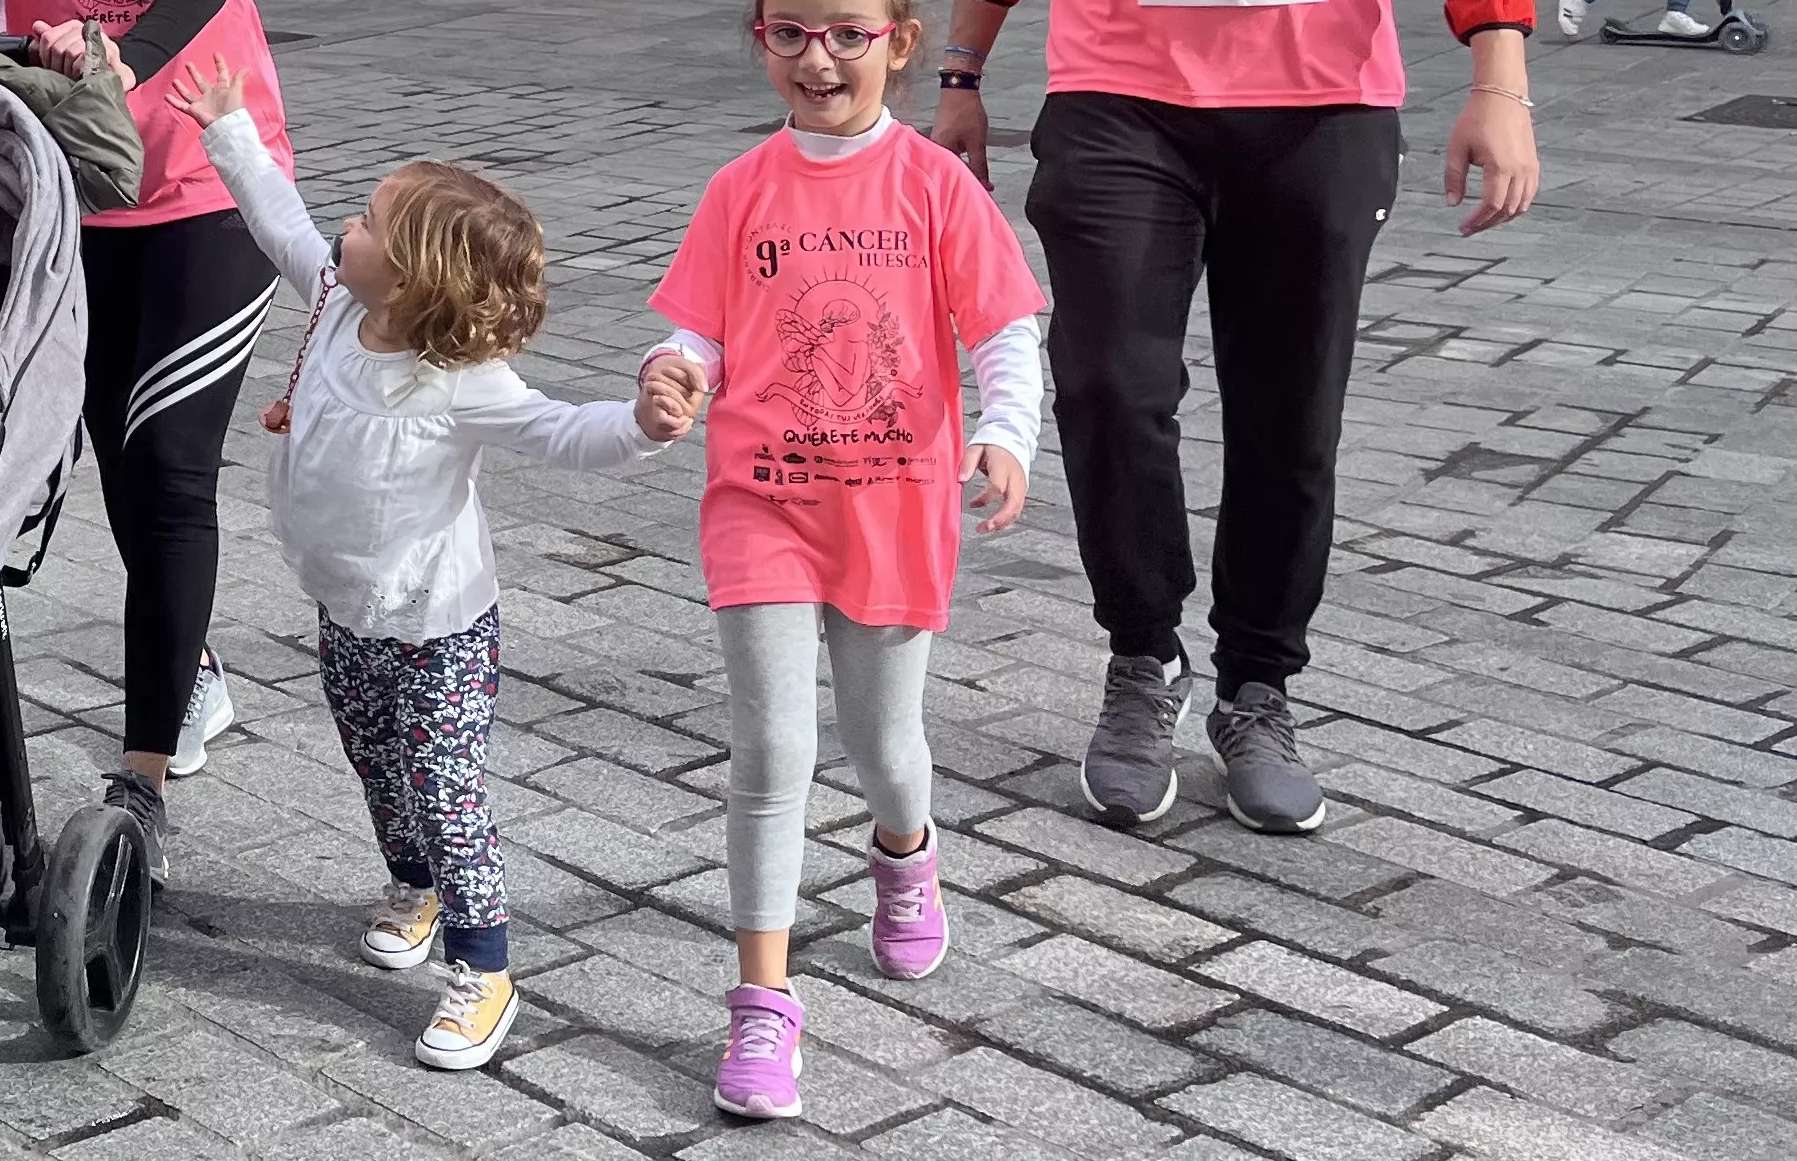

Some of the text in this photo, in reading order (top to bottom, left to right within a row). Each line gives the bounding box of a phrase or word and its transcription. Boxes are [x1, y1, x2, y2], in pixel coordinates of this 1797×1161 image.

[756, 227, 909, 279] 9ª CÁNCER
[858, 252, 929, 269] HUESCA
[783, 427, 914, 447] QUIÉRETE MUCHO
